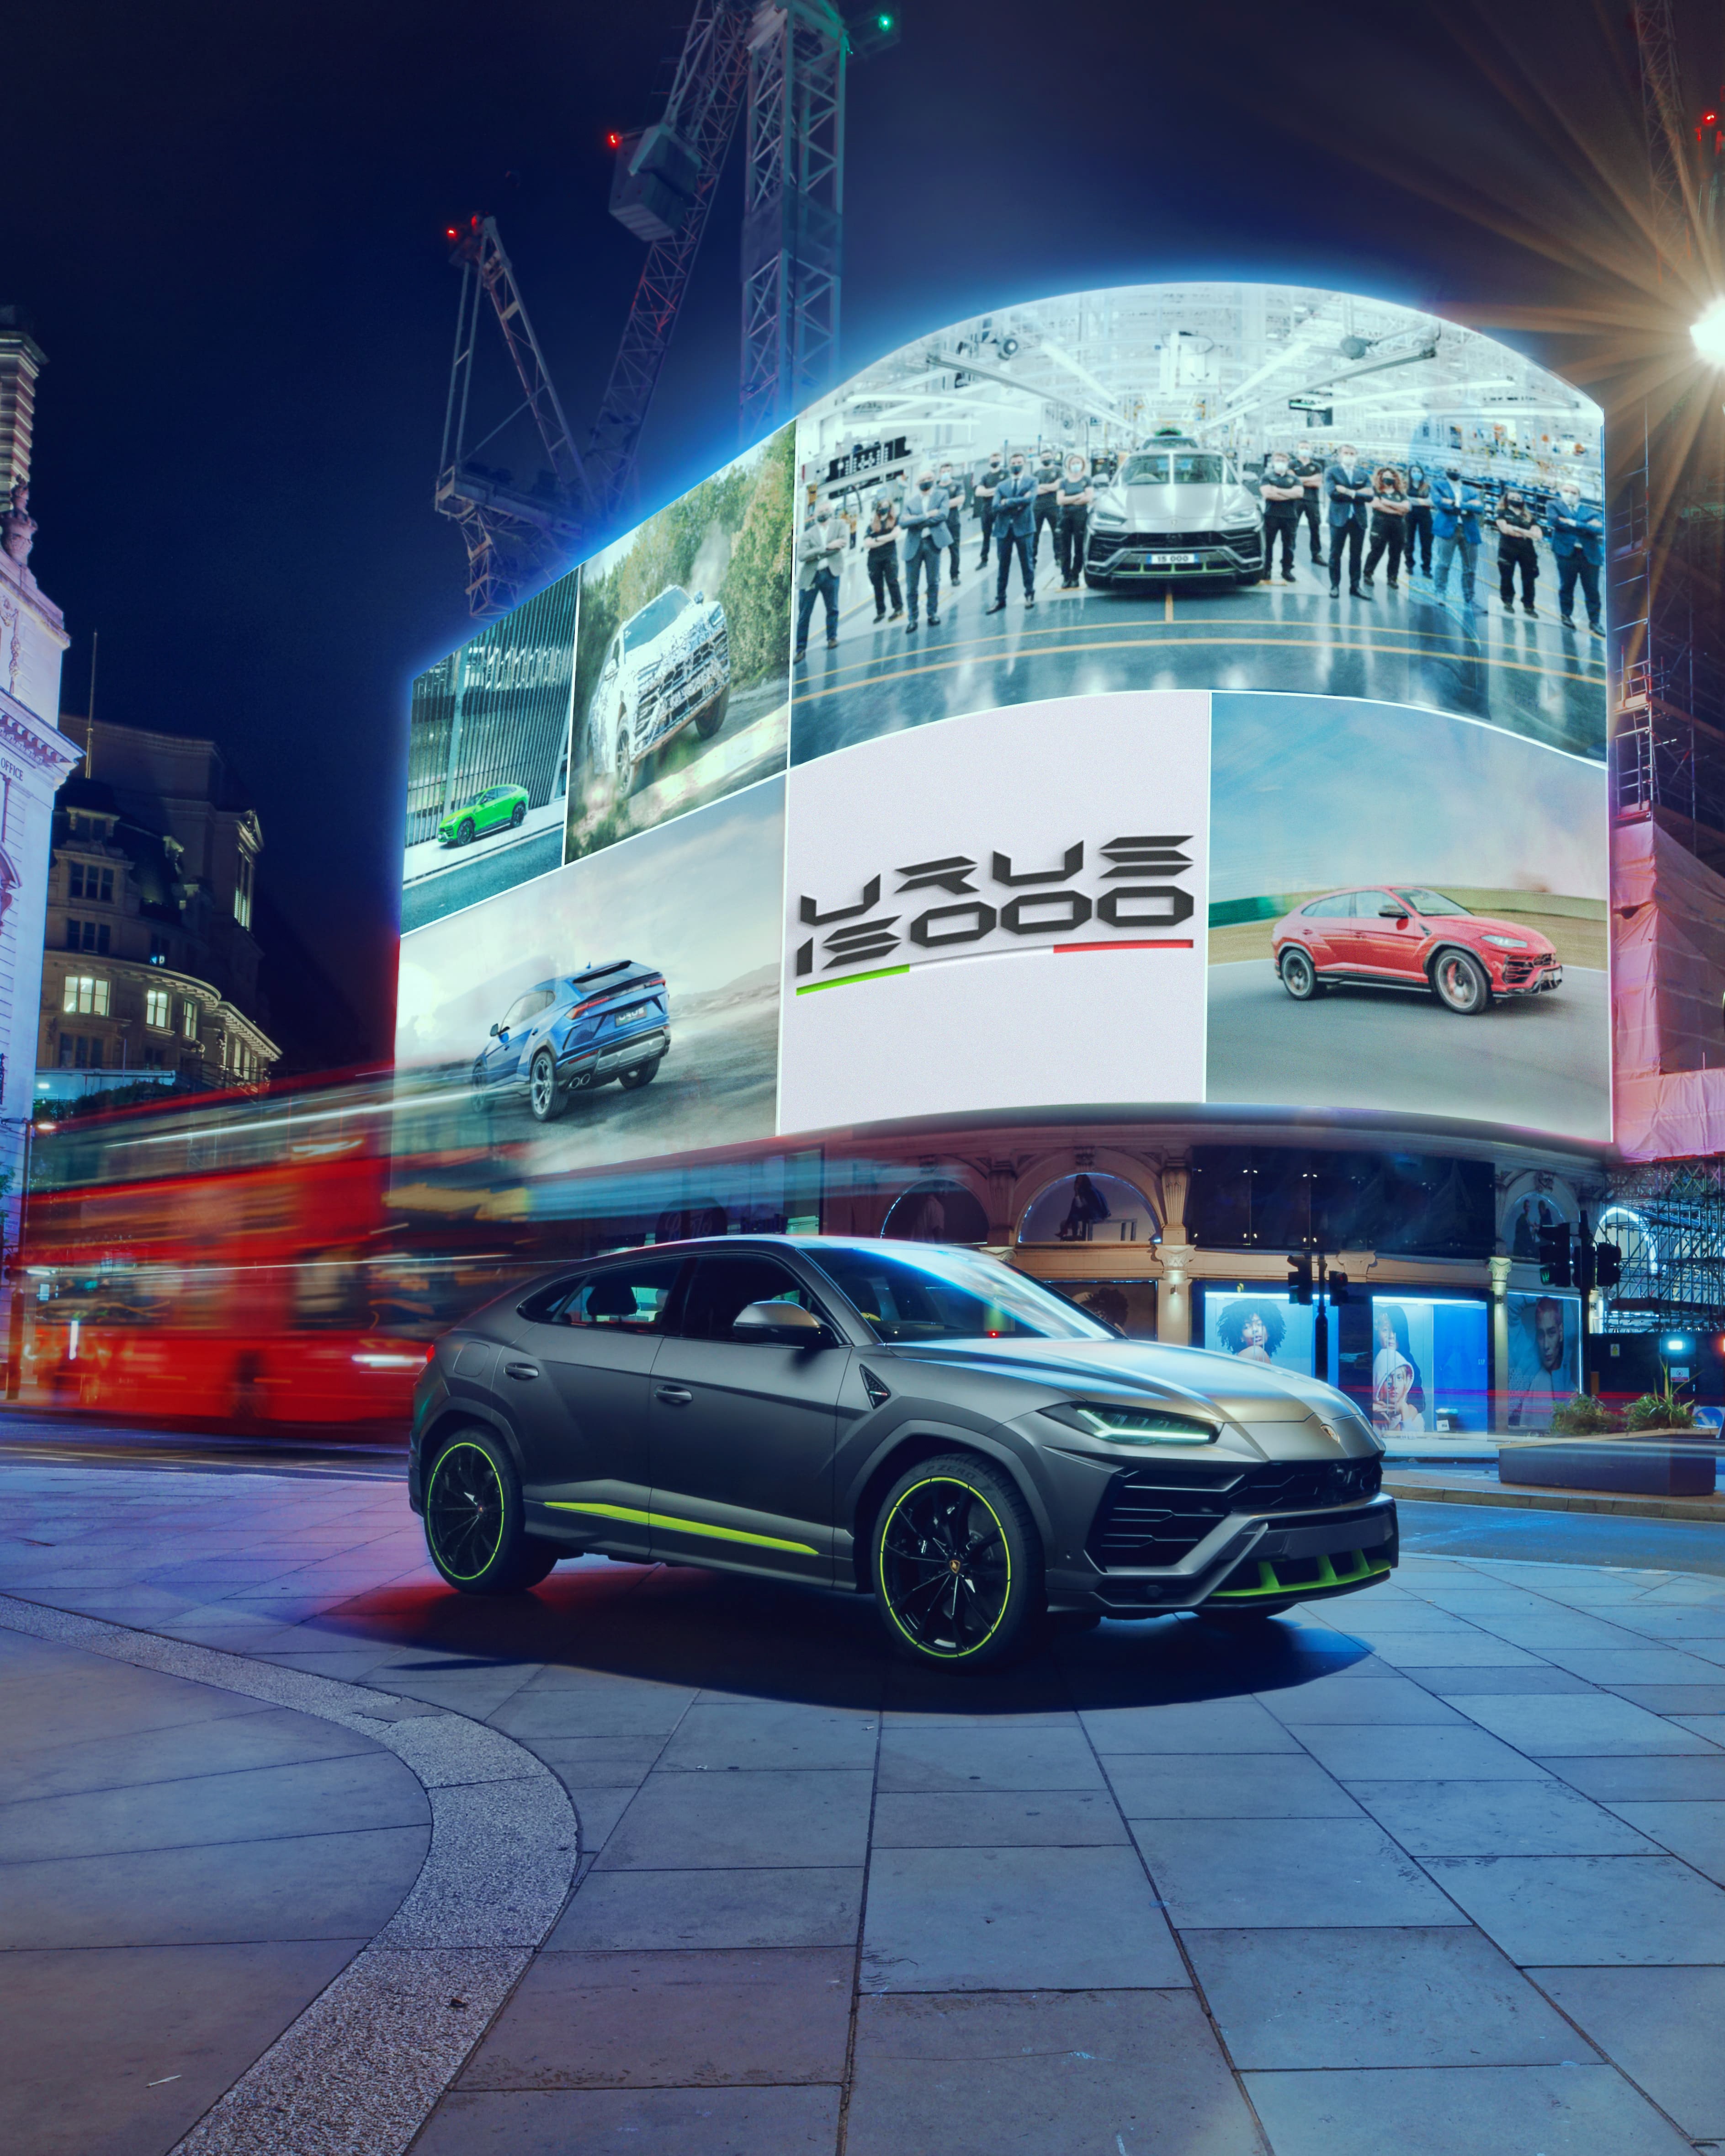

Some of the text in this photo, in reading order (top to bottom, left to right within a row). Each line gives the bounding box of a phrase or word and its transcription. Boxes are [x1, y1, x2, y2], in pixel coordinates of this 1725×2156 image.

[1, 757, 23, 781] OFFICE
[799, 835, 1194, 926] URUS
[796, 885, 1195, 977] 15000
[937, 1464, 976, 1479] ZERO
